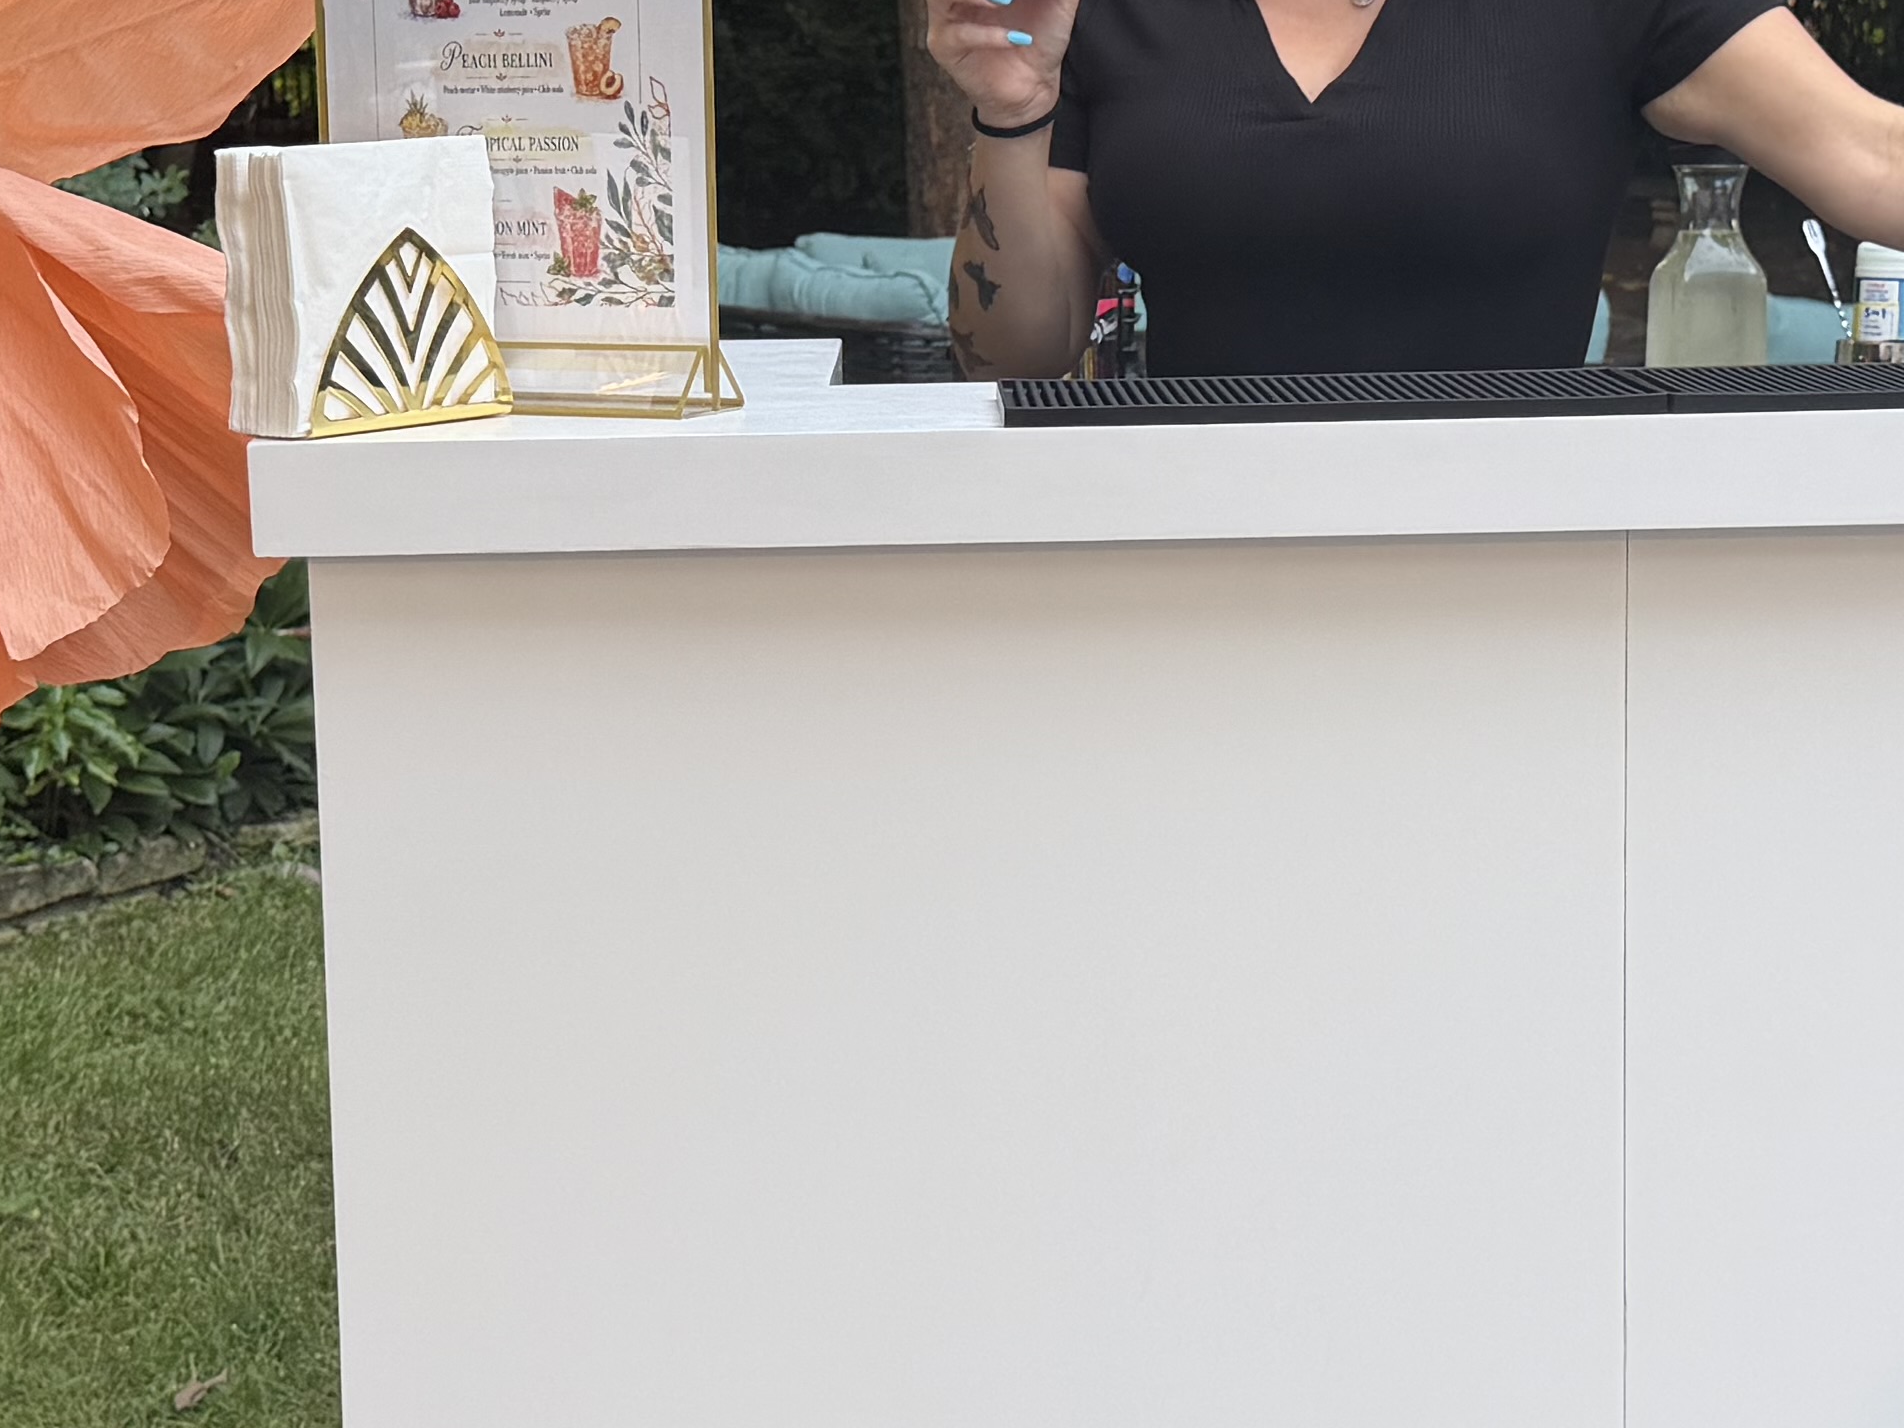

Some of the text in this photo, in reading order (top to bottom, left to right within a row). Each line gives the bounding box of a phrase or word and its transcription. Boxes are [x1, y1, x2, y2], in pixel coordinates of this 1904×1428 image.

[440, 41, 553, 71] PEACH BELLINI
[528, 136, 579, 152] PASSION
[517, 220, 547, 236] MINT
